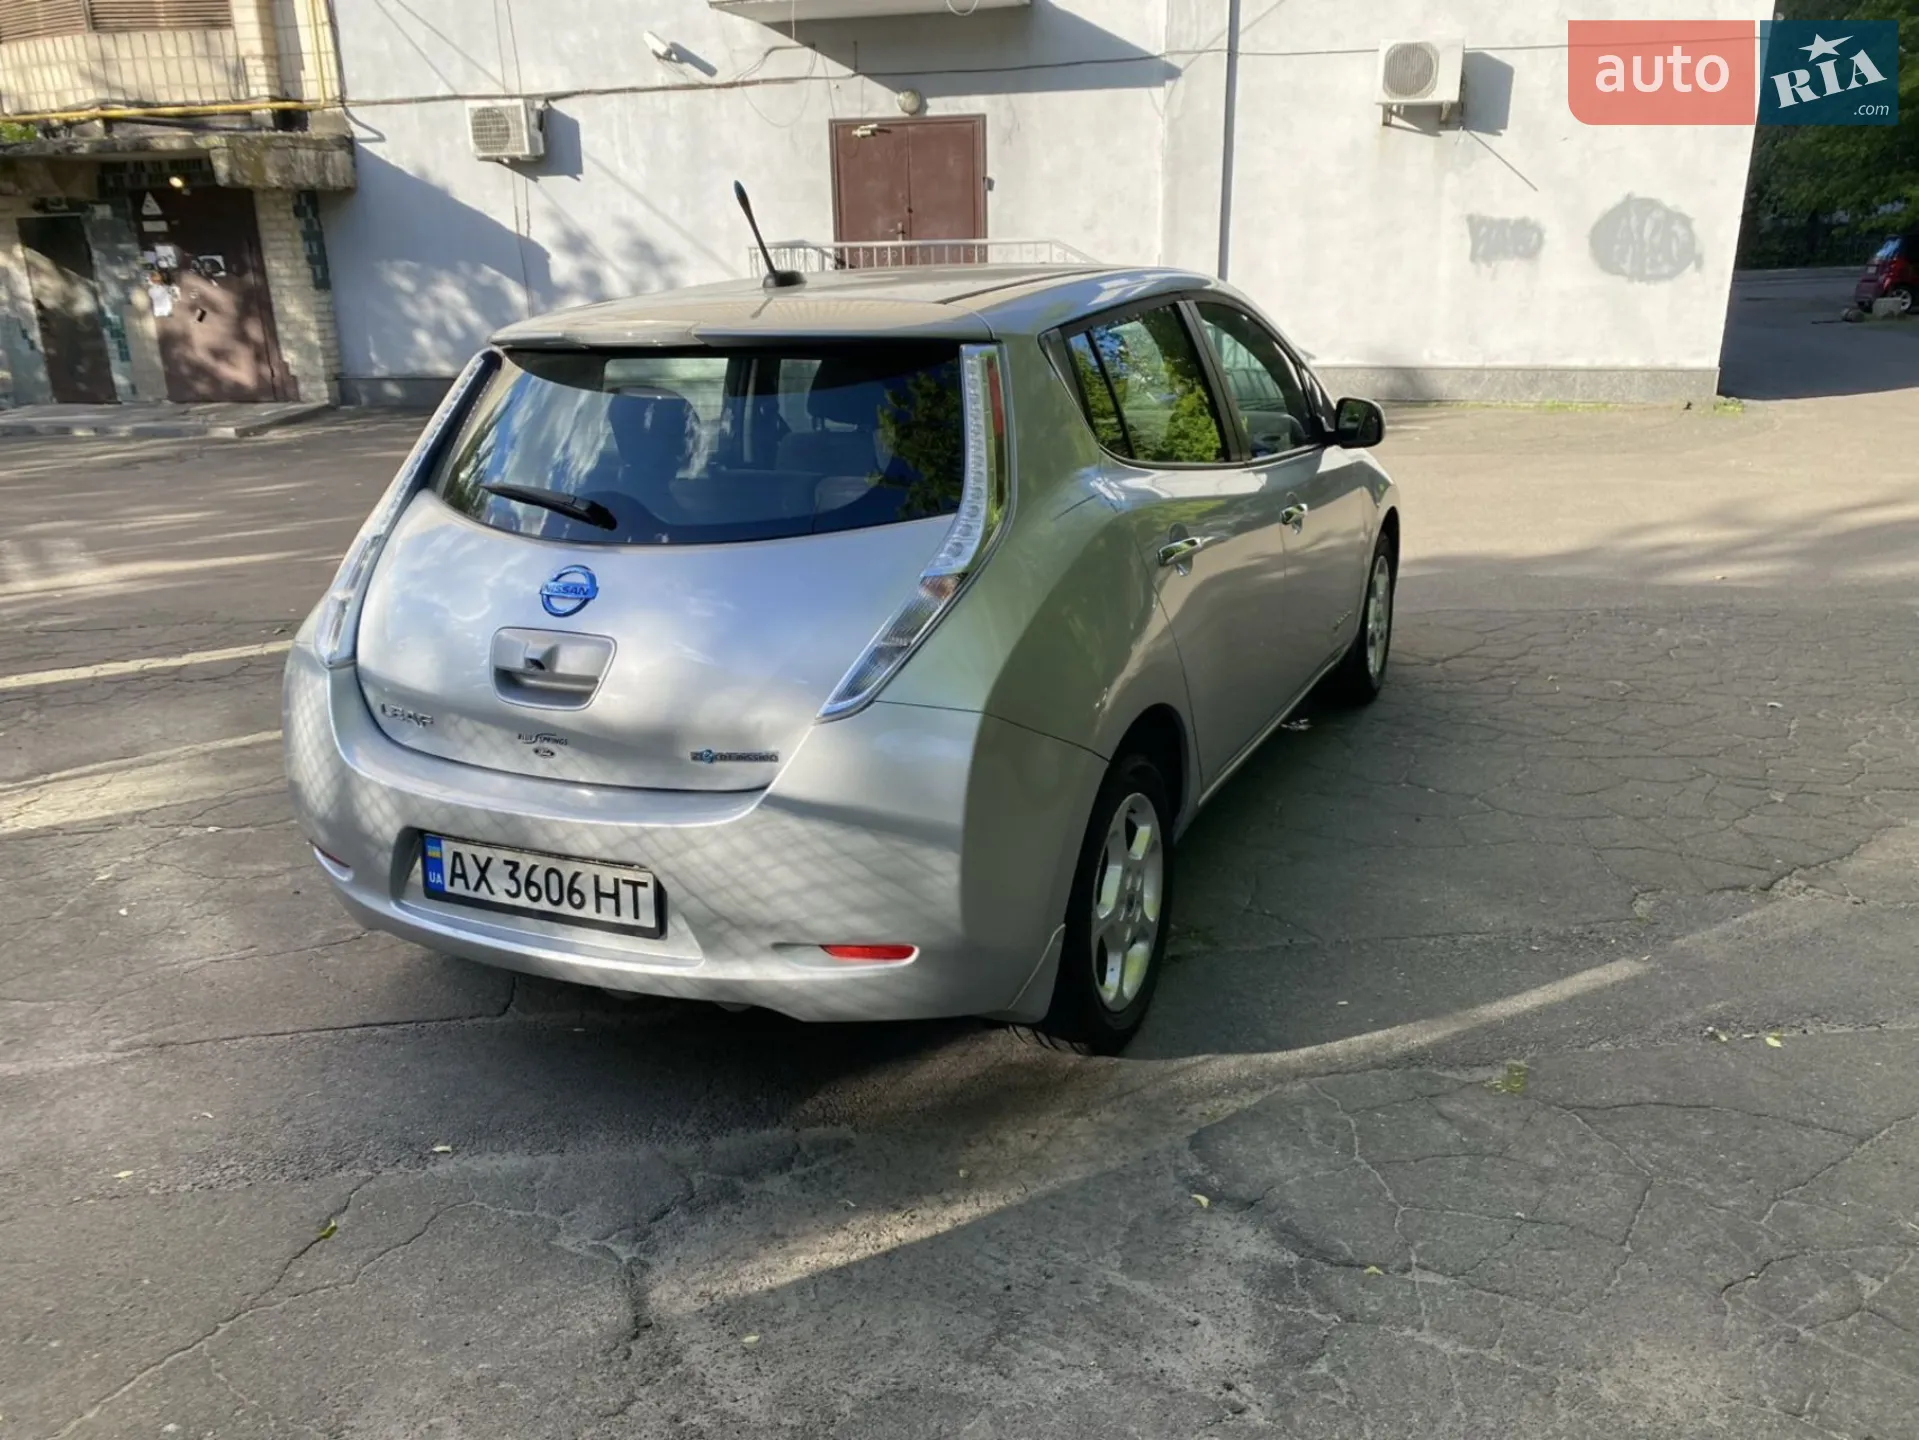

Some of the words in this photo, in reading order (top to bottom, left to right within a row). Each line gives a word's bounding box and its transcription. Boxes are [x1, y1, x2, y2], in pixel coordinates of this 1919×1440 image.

[542, 583, 590, 596] NISSAN
[380, 702, 434, 728] LEAF
[428, 871, 444, 885] UA
